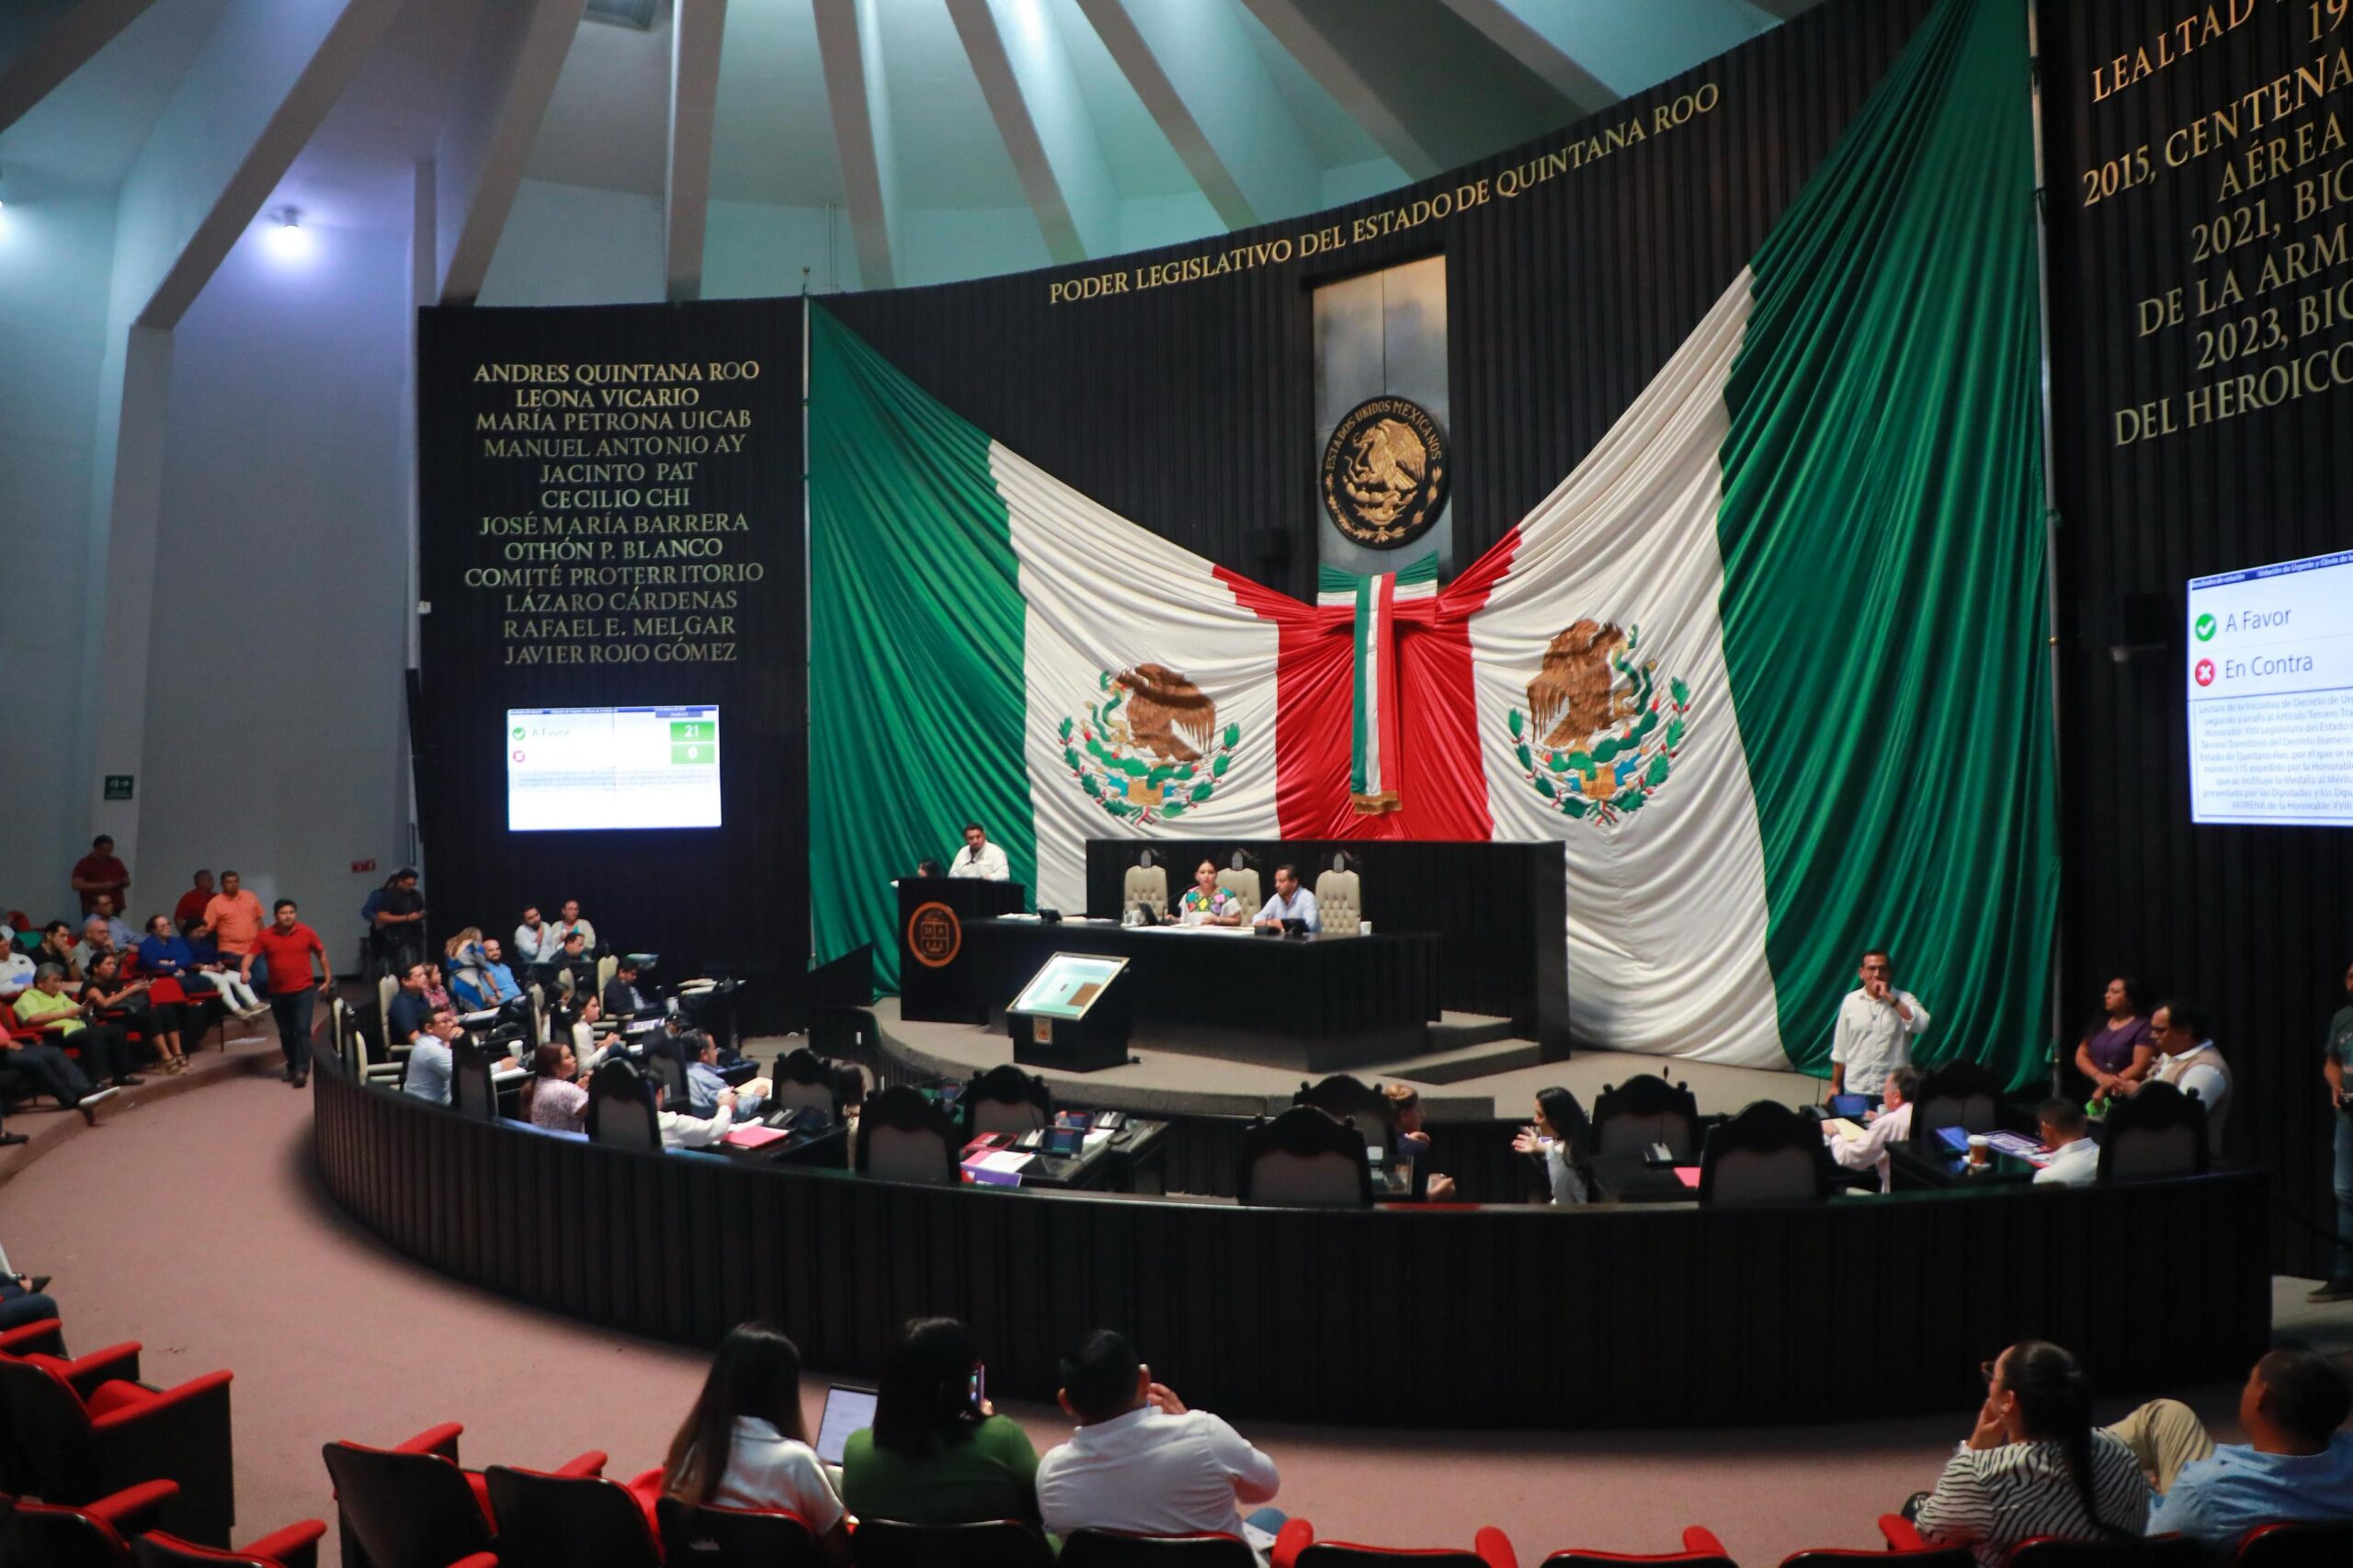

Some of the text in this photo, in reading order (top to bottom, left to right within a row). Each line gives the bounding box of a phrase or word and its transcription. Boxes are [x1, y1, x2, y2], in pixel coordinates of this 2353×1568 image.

[2092, 0, 2256, 104] LEALTAD
[2083, 47, 2353, 209] 2015, CENTENA
[2216, 111, 2347, 203] AÉREA
[1050, 83, 1720, 304] PODER LEGISLATIVO DEL ESTADO DE QUINTANA ROO
[2190, 199, 2281, 264] 2021,
[2138, 222, 2353, 337] DE LA ARM
[2196, 307, 2289, 369] 2023,
[473, 361, 759, 386] ANDRES QUINTANA ROO
[516, 388, 699, 408] LEONA VICARIO
[2114, 341, 2353, 447] DEL HEROICO
[476, 409, 751, 431] MARÍA PETRONA UICAB
[484, 434, 745, 457] MANUEL ANTONIO AY
[1325, 400, 1441, 470] ESTADOS UNIDOS MEXICANOS
[540, 462, 698, 483] JACINTO PAT
[541, 488, 689, 508] CECILIO CHI
[479, 511, 749, 536] JOSÉ MARÍA BARRERA
[505, 537, 722, 560] OTHÓN P. BLANCO
[464, 562, 764, 587] COMITÉ PROTERRITORIO
[506, 586, 737, 612] LÁZARO CÁRDENAS
[505, 616, 735, 638] RAFAEL E. MELGAR
[2225, 608, 2292, 632] A Favor
[505, 636, 736, 664] JAVIER ROJO GÓMEZ
[2225, 654, 2313, 679] En Contra
[542, 728, 570, 737] Favor
[685, 724, 699, 737] 21
